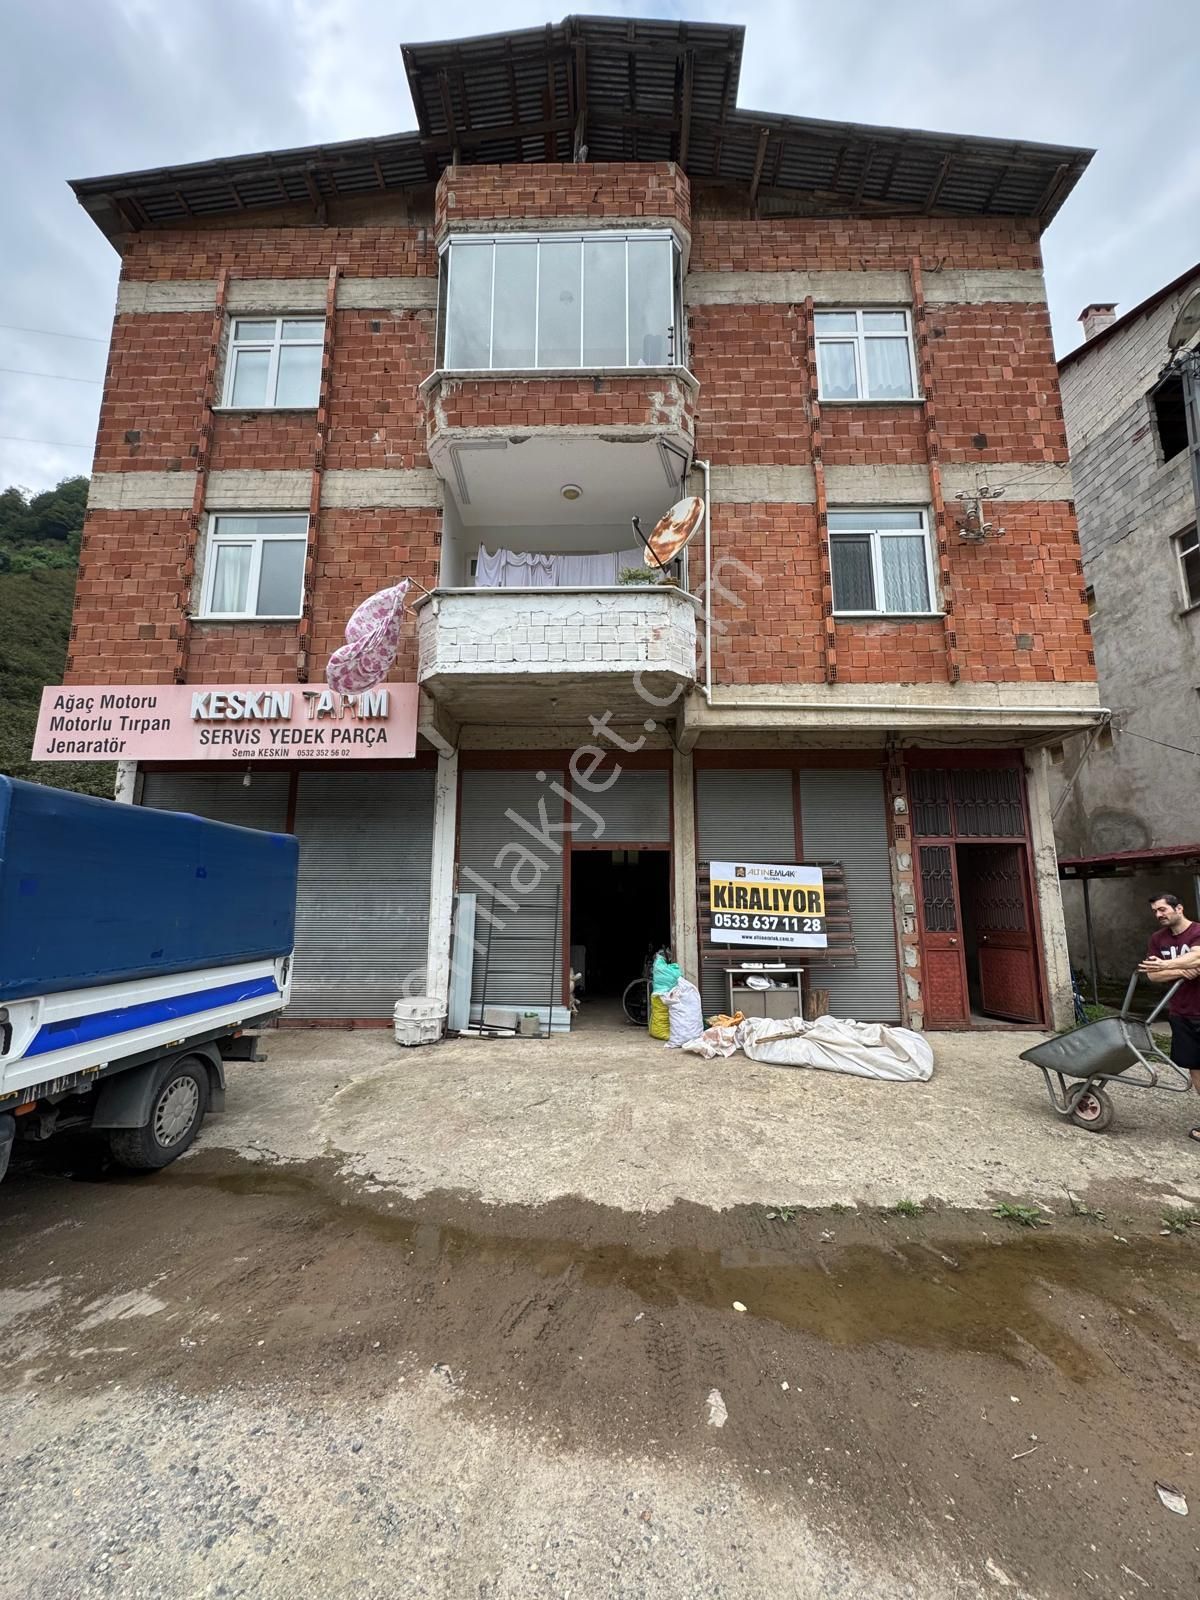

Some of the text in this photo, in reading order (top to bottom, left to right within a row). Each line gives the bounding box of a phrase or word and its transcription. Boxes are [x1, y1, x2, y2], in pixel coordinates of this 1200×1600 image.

[54, 694, 157, 713] Ağaç Motoru
[302, 689, 390, 720] TARIM
[49, 716, 171, 734] Motorlu Tırpan
[47, 737, 126, 753] Jenaratör
[270, 728, 325, 744] YEDEK
[331, 727, 387, 748] PARÇA
[232, 748, 255, 757] Sema
[297, 749, 314, 757] 0532
[316, 749, 329, 757] 352
[330, 749, 340, 757] 56
[341, 749, 350, 757] 02
[714, 882, 821, 913] KİRALIYOR
[714, 913, 821, 932] 0533 637 11 28
